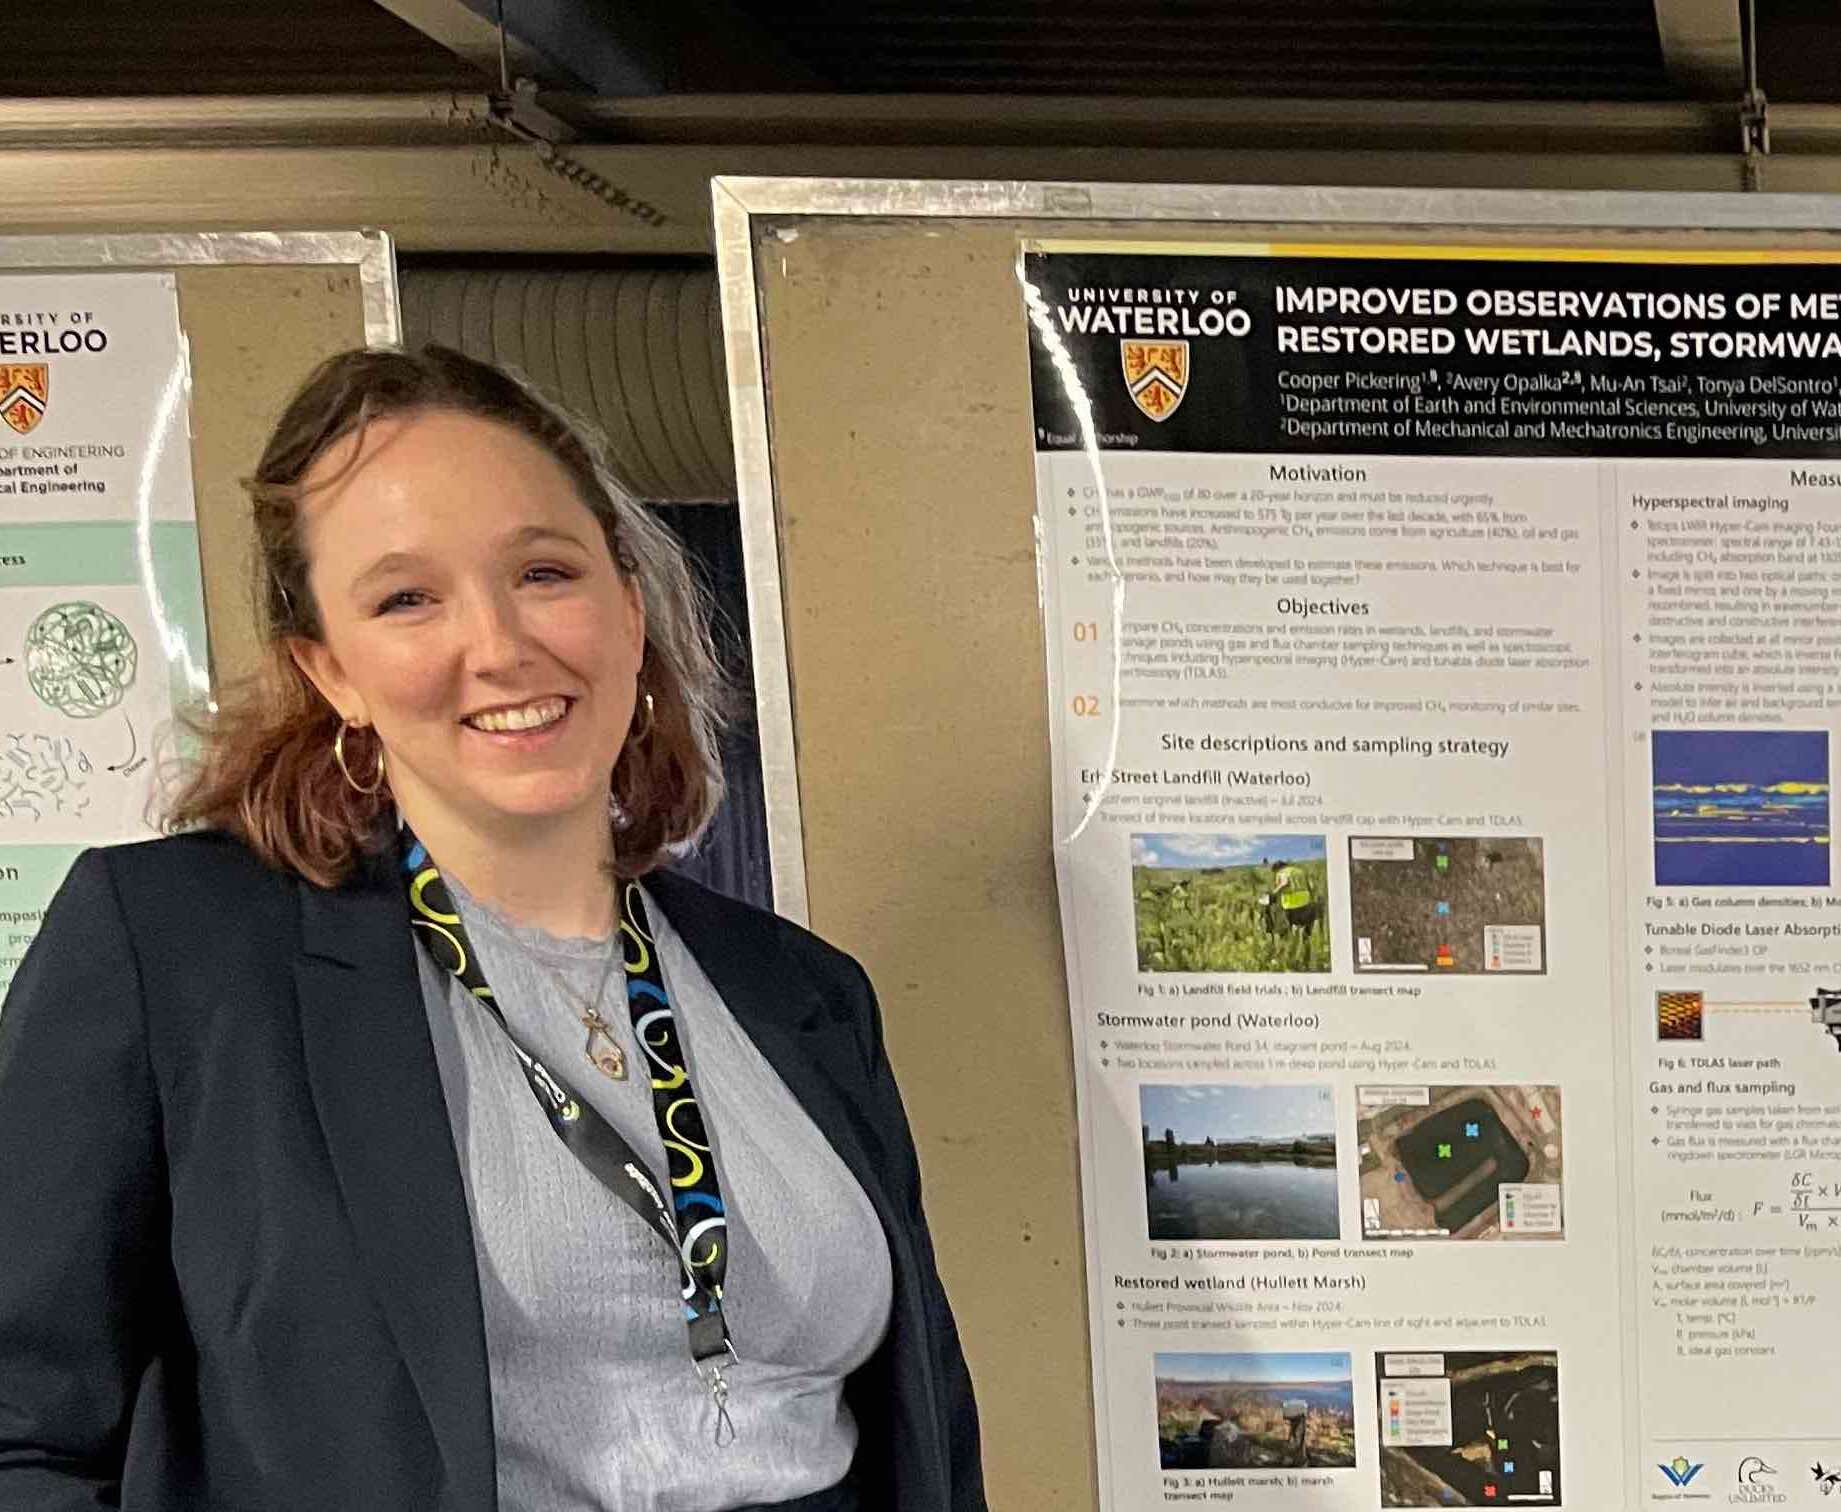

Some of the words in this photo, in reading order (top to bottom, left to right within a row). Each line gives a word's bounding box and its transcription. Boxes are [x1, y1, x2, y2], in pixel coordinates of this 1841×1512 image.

[1067, 288, 1200, 303] UNIVERSITY
[1210, 290, 1238, 304] OF
[1274, 286, 1459, 315] IMPROVED
[1465, 289, 1728, 320] OBSERVATIONS
[1734, 293, 1782, 320] OF
[70, 312, 93, 325] OF
[1054, 306, 1253, 337] WATERLOO
[1277, 326, 1456, 354] RESTORED
[1464, 328, 1661, 362] WETLANDS,
[1277, 372, 1342, 397] Cooper
[1590, 376, 1646, 393] Mu-An
[1696, 378, 1746, 397] Tonya
[1392, 395, 1411, 412] of
[1413, 396, 1461, 413] Earth
[1462, 397, 1497, 415] and
[1499, 397, 1622, 416] Environmental
[1623, 399, 1702, 417] Sciences,
[1703, 400, 1788, 421] University
[1789, 399, 1809, 416] of
[1392, 419, 1413, 437] of
[1414, 419, 1511, 438] Mechanical
[1512, 421, 1547, 438] and
[1549, 421, 1663, 439] Mechatronics
[1665, 422, 1769, 444] Engineering,
[1268, 465, 1368, 481] Motivation
[20, 480, 106, 496] Engineering
[1631, 495, 1729, 511] Hyperspectral
[1732, 496, 1790, 512] imaging
[1276, 598, 1370, 618] Objectives
[1071, 622, 1099, 642] 01
[1071, 696, 1101, 717] 02
[1161, 734, 1195, 751] Site
[1199, 734, 1309, 755] descriptions
[1313, 736, 1348, 751] and
[1351, 736, 1434, 757] sampling
[1437, 739, 1510, 758] strategy
[1110, 770, 1159, 784] Street
[1162, 770, 1223, 784] Landfill
[1226, 771, 1312, 787] (Waterloo)
[1643, 923, 1698, 936] Tunable
[1700, 923, 1742, 936] Diode
[1744, 924, 1781, 936] Laser
[1096, 1013, 1186, 1027] Stormwater
[1190, 1013, 1232, 1029] pond
[1236, 1013, 1320, 1030] (Waterloo)
[1657, 1058, 1676, 1070] Fig
[1648, 1081, 1674, 1094] Gas
[1677, 1081, 1703, 1093] and
[1706, 1081, 1732, 1093] flux
[1734, 1081, 1796, 1097] sampling
[1112, 1275, 1181, 1289] Restored
[1183, 1276, 1247, 1289] wetland
[1249, 1276, 1310, 1290] (Hullett
[1312, 1276, 1367, 1289] Marsh)
